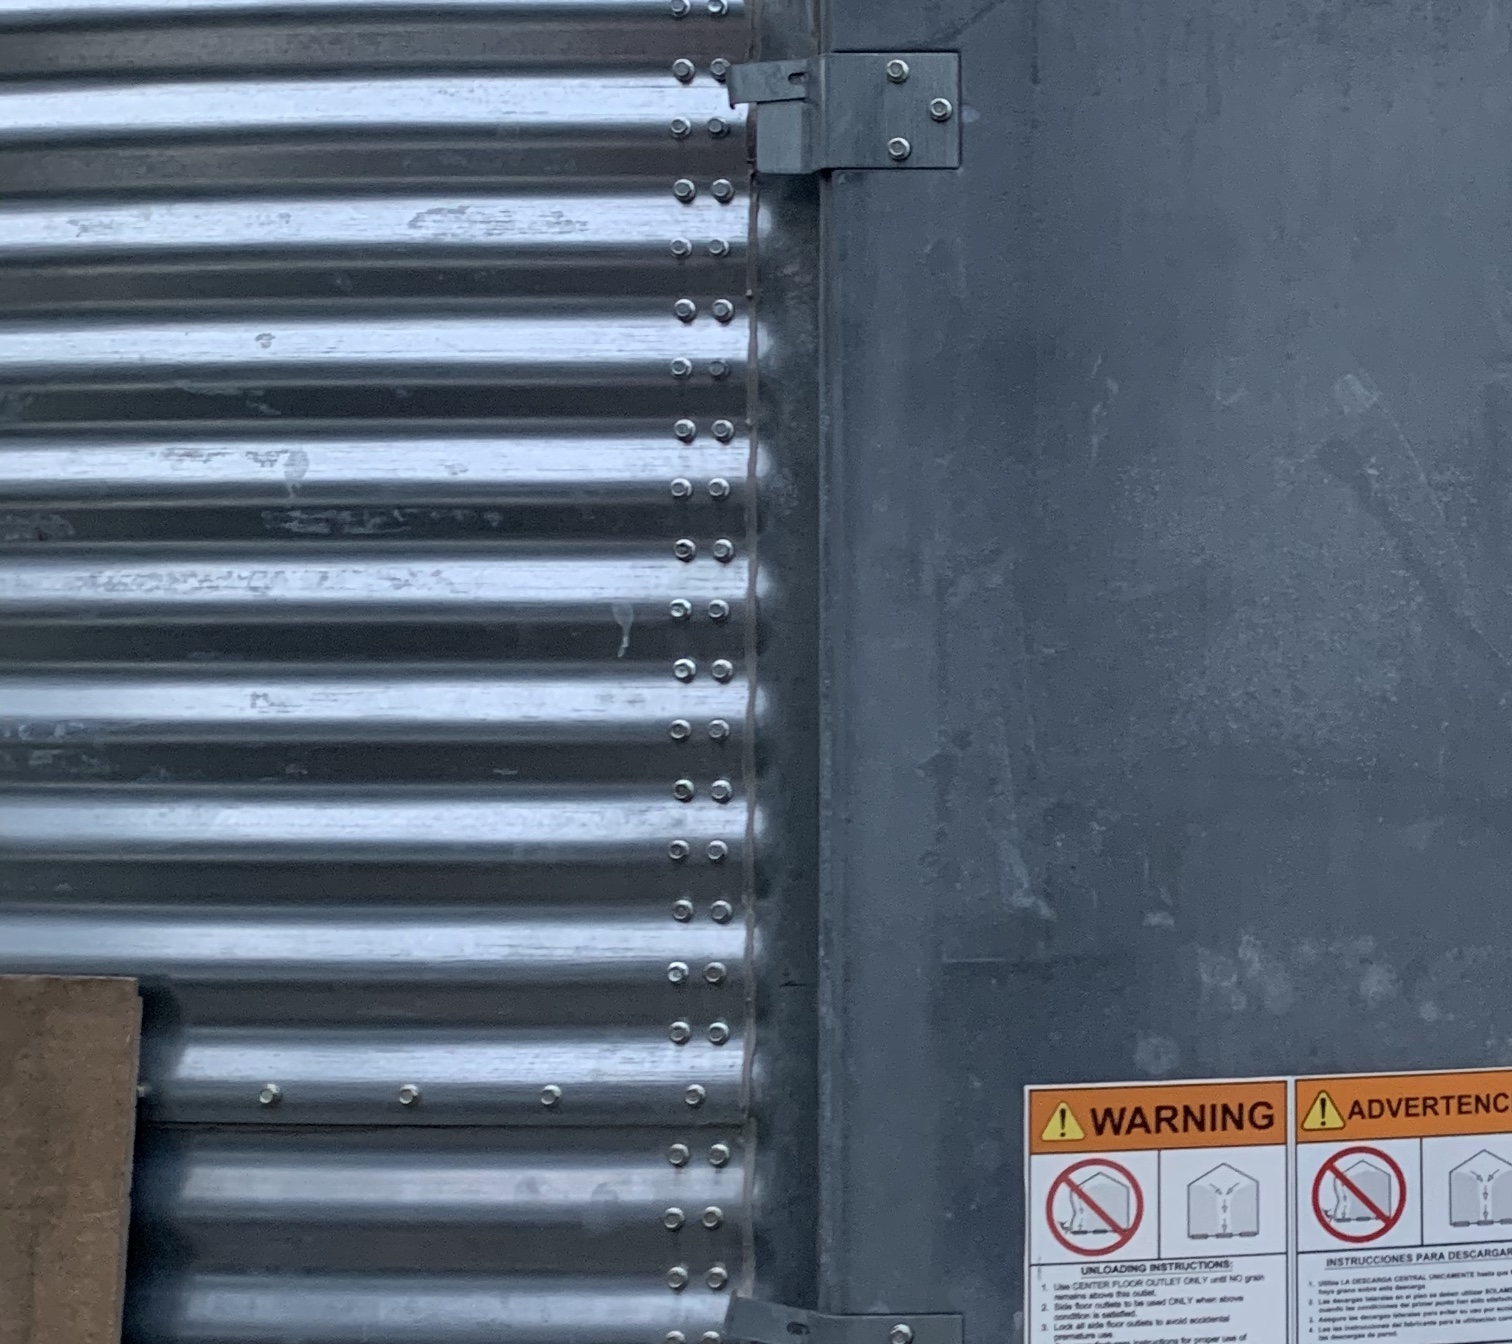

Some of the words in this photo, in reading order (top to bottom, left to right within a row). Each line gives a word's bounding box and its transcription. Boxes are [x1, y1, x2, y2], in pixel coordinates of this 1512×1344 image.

[1091, 1101, 1275, 1136] WARNING
[1326, 1253, 1413, 1267] INSTRUCCIONES
[1416, 1252, 1445, 1262] PARA
[1081, 1264, 1146, 1275] UNLOADING
[1073, 1281, 1109, 1290] CENTER
[1112, 1280, 1143, 1288] FLOOR
[1146, 1277, 1181, 1286] OUTLET
[1184, 1276, 1208, 1285] ONLY
[1168, 1297, 1193, 1305] ONLY
